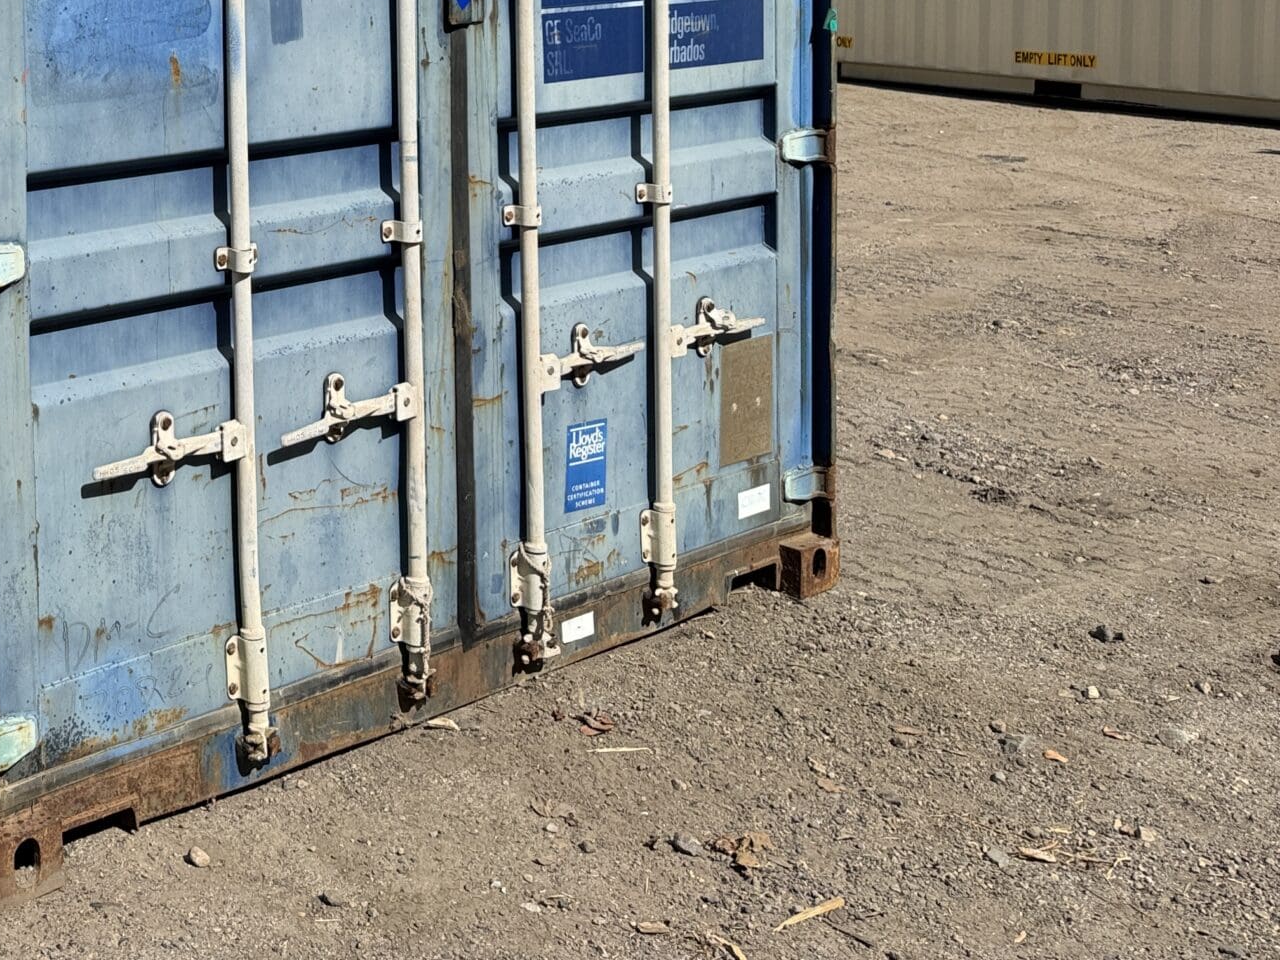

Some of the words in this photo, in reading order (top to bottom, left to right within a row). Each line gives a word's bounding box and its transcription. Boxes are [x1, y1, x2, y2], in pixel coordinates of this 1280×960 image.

[545, 19, 561, 45] GE
[565, 16, 602, 43] SeaCo
[670, 38, 705, 64] rbados
[1015, 51, 1043, 64] EMPTY
[1047, 53, 1067, 65] LIFT
[1070, 55, 1096, 67] ONLY
[572, 427, 604, 446] Lloyd's
[569, 442, 606, 460] Register
[567, 488, 604, 501] CERTIFICATION
[572, 480, 600, 492] CONTAINER
